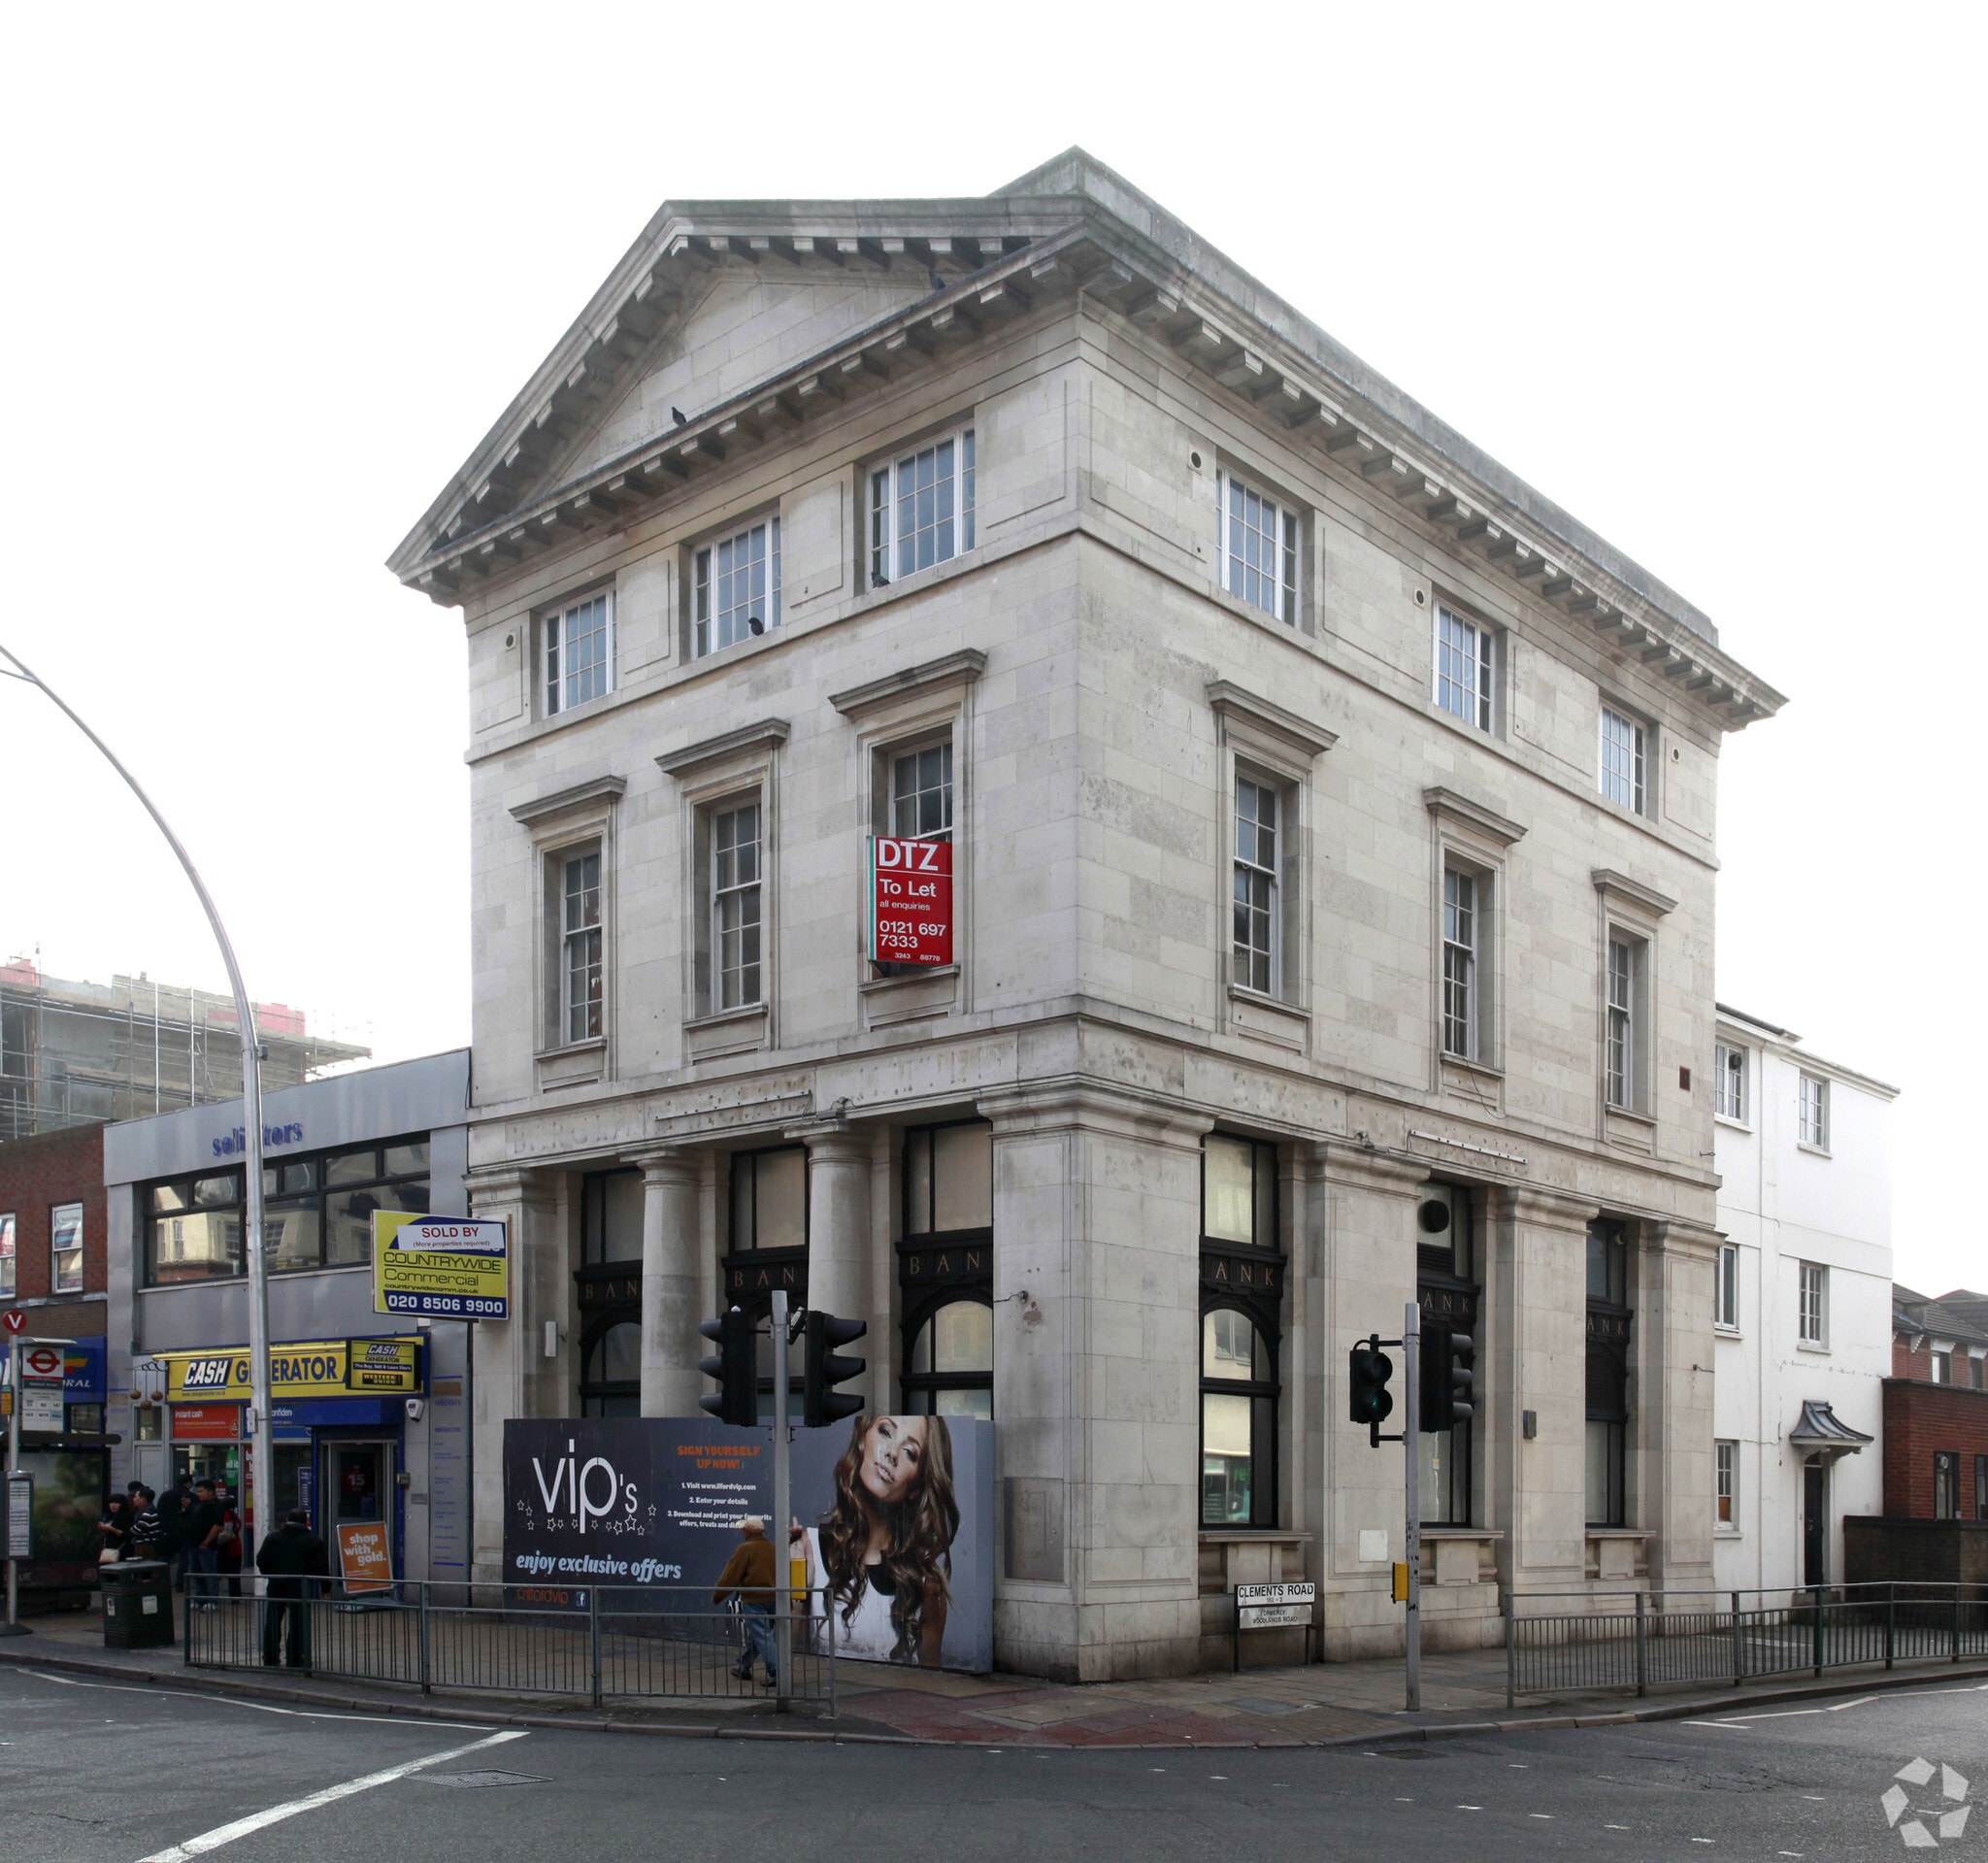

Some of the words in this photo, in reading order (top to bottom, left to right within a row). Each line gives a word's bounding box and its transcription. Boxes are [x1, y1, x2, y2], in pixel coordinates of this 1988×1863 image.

[878, 839, 939, 871] DTZ
[879, 878, 902, 895] To
[908, 881, 937, 898] Let
[891, 901, 931, 911] enquiries
[879, 920, 912, 934] 0121
[918, 923, 946, 937] 697
[879, 934, 918, 948] 7333
[213, 1122, 303, 1156] solitors
[421, 1227, 458, 1238] SOLD
[463, 1226, 480, 1237] BY
[383, 1251, 501, 1272] COUNTRYWIDE
[910, 1252, 980, 1276] BAN
[384, 1268, 479, 1286] Commercial
[734, 1268, 795, 1287] BAN
[1215, 1261, 1274, 1286] ANK
[384, 1283, 479, 1294] countrywidecomm.co.uk
[585, 1281, 638, 1299] BAN
[388, 1294, 417, 1309] 020
[423, 1296, 461, 1311] 8506
[466, 1299, 503, 1314] 9900
[1423, 1292, 1469, 1314] ANK
[8, 1314, 22, 1329] V
[1586, 1317, 1624, 1336] ANK
[368, 1344, 399, 1355] CASH
[184, 1360, 229, 1385] CASH
[236, 1355, 338, 1384] GERATOR
[62, 1379, 91, 1388] RAL
[175, 1410, 191, 1418] Instant
[191, 1410, 203, 1418] cash
[678, 1446, 703, 1455] SIGN
[705, 1446, 761, 1456] YOURSELF
[696, 1459, 712, 1469] UP
[712, 1459, 742, 1470] NOW!
[532, 1439, 638, 1534] vip's
[701, 1482, 756, 1492] www.ilfordvip.com
[712, 1498, 727, 1507] your
[679, 1519, 699, 1528] offers,
[713, 1512, 728, 1520] print
[729, 1513, 744, 1521] your
[349, 1532, 379, 1547] shop
[345, 1544, 371, 1556] with
[357, 1550, 387, 1567] gold.
[515, 1549, 557, 1575] enjoy
[558, 1553, 628, 1576] exclusive
[631, 1557, 682, 1583] offers
[1239, 1584, 1284, 1598] CLEMENTS
[1287, 1584, 1314, 1596] ROAD
[1252, 1615, 1282, 1624] WOODLANDS
